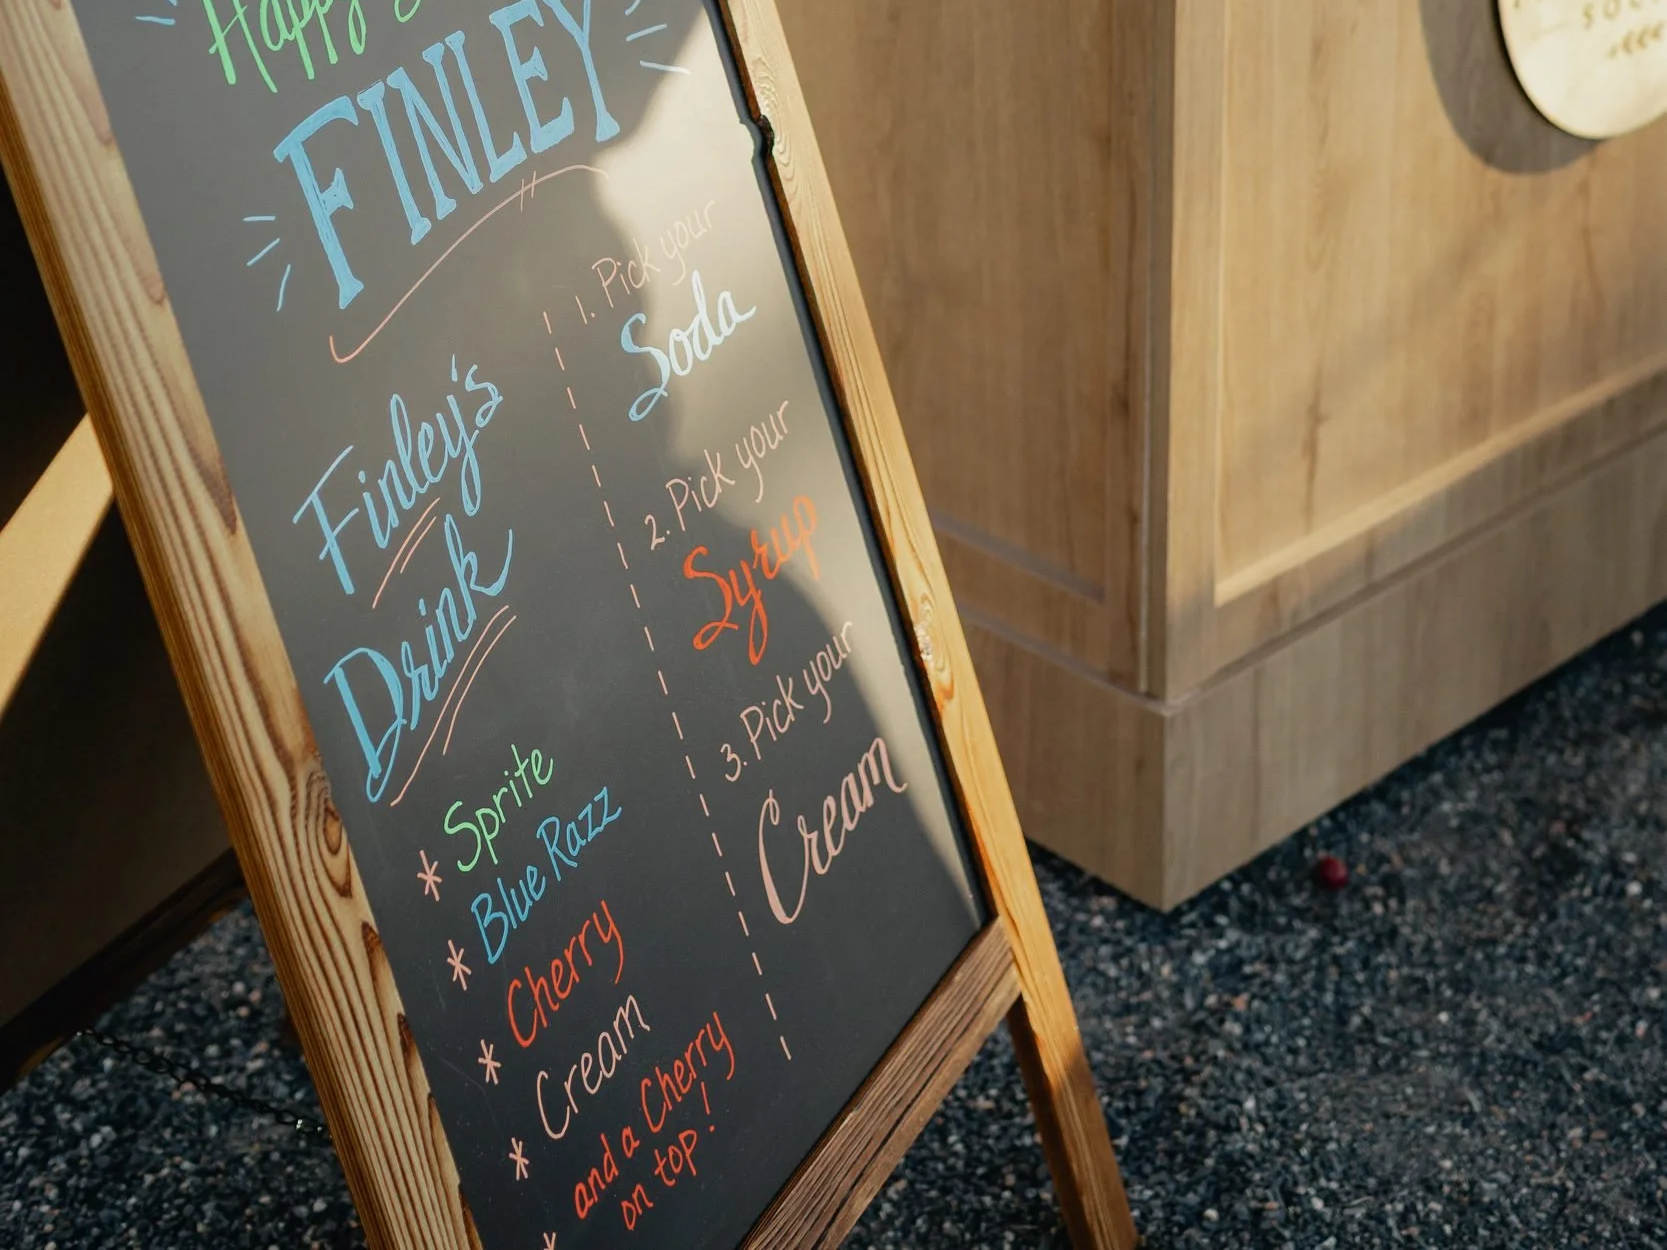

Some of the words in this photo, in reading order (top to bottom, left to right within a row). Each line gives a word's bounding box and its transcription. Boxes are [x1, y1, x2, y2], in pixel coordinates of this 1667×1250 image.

[591, 237, 662, 309] Pick
[660, 199, 716, 287] your
[620, 269, 758, 422] Soda
[292, 352, 504, 595] Finley's
[644, 514, 671, 551] 2.
[665, 449, 736, 532] Pick
[735, 400, 790, 504] your
[322, 513, 514, 802] Drink
[683, 494, 818, 666] Syrup
[720, 743, 750, 782] 3.
[740, 674, 804, 761] Pick
[801, 620, 855, 725] your
[443, 743, 555, 873] Sprite
[470, 863, 546, 964] Blue
[536, 785, 623, 882] Razz
[757, 736, 908, 925] Cream
[506, 900, 625, 1048] Cherry
[536, 994, 651, 1140] Cream
[573, 1133, 619, 1220] and
[621, 1125, 641, 1158] a
[640, 1011, 736, 1133] Cherry
[620, 1183, 654, 1231] on
